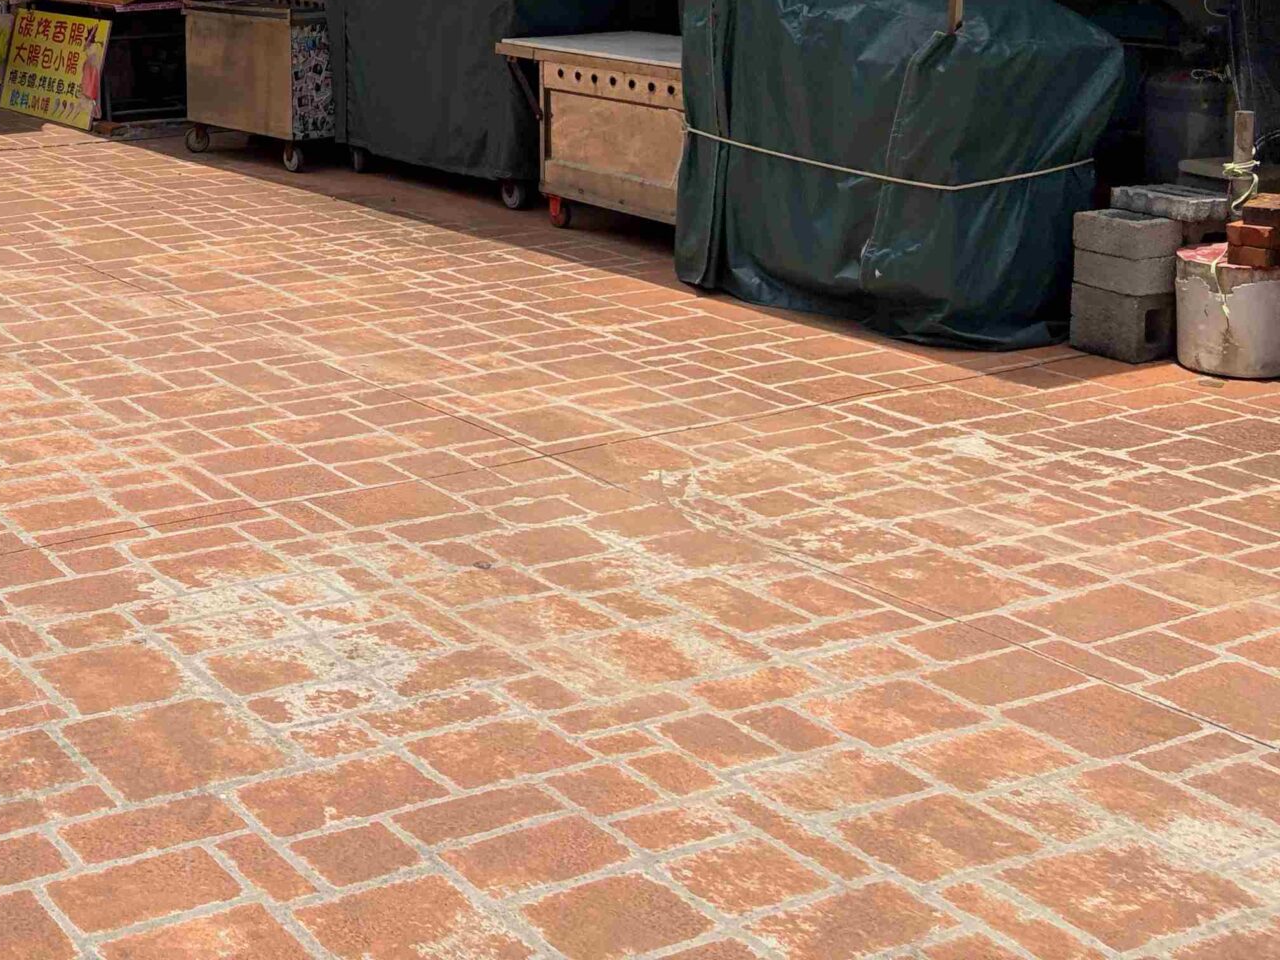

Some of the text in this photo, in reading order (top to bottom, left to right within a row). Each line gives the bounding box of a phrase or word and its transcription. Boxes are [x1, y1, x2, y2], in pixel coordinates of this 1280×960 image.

[17, 12, 85, 46] 碳烤香腸
[13, 42, 80, 76] 大腸包小腸
